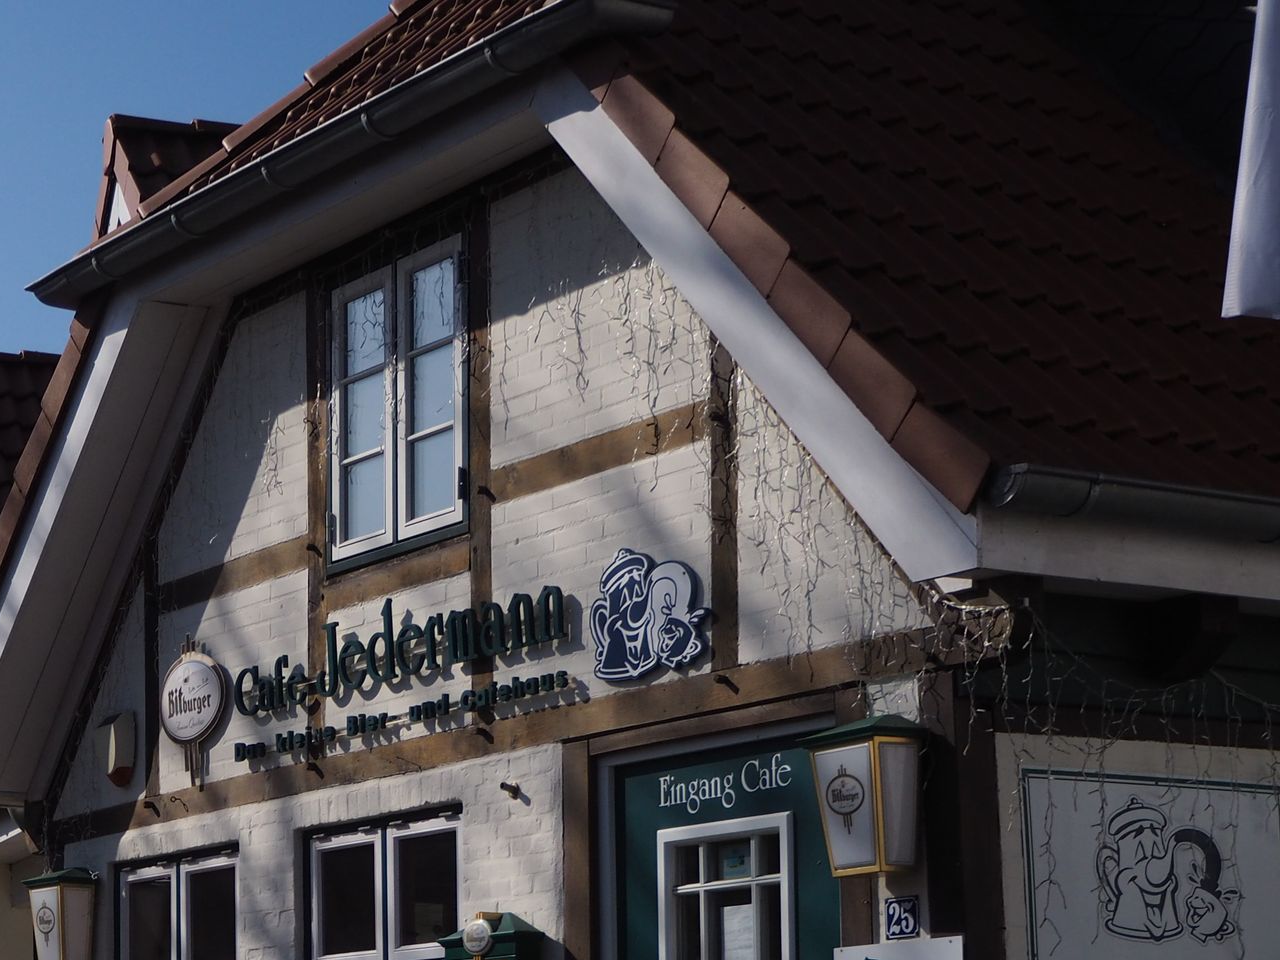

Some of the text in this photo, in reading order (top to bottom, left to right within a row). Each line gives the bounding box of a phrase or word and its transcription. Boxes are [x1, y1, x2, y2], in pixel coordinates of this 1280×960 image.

[234, 585, 569, 716] Cafe Jedermann
[168, 686, 211, 719] Bitburger
[234, 742, 266, 762] Das
[409, 693, 449, 722] und
[658, 753, 792, 814] Eingang Cafe
[888, 902, 914, 935] 25
